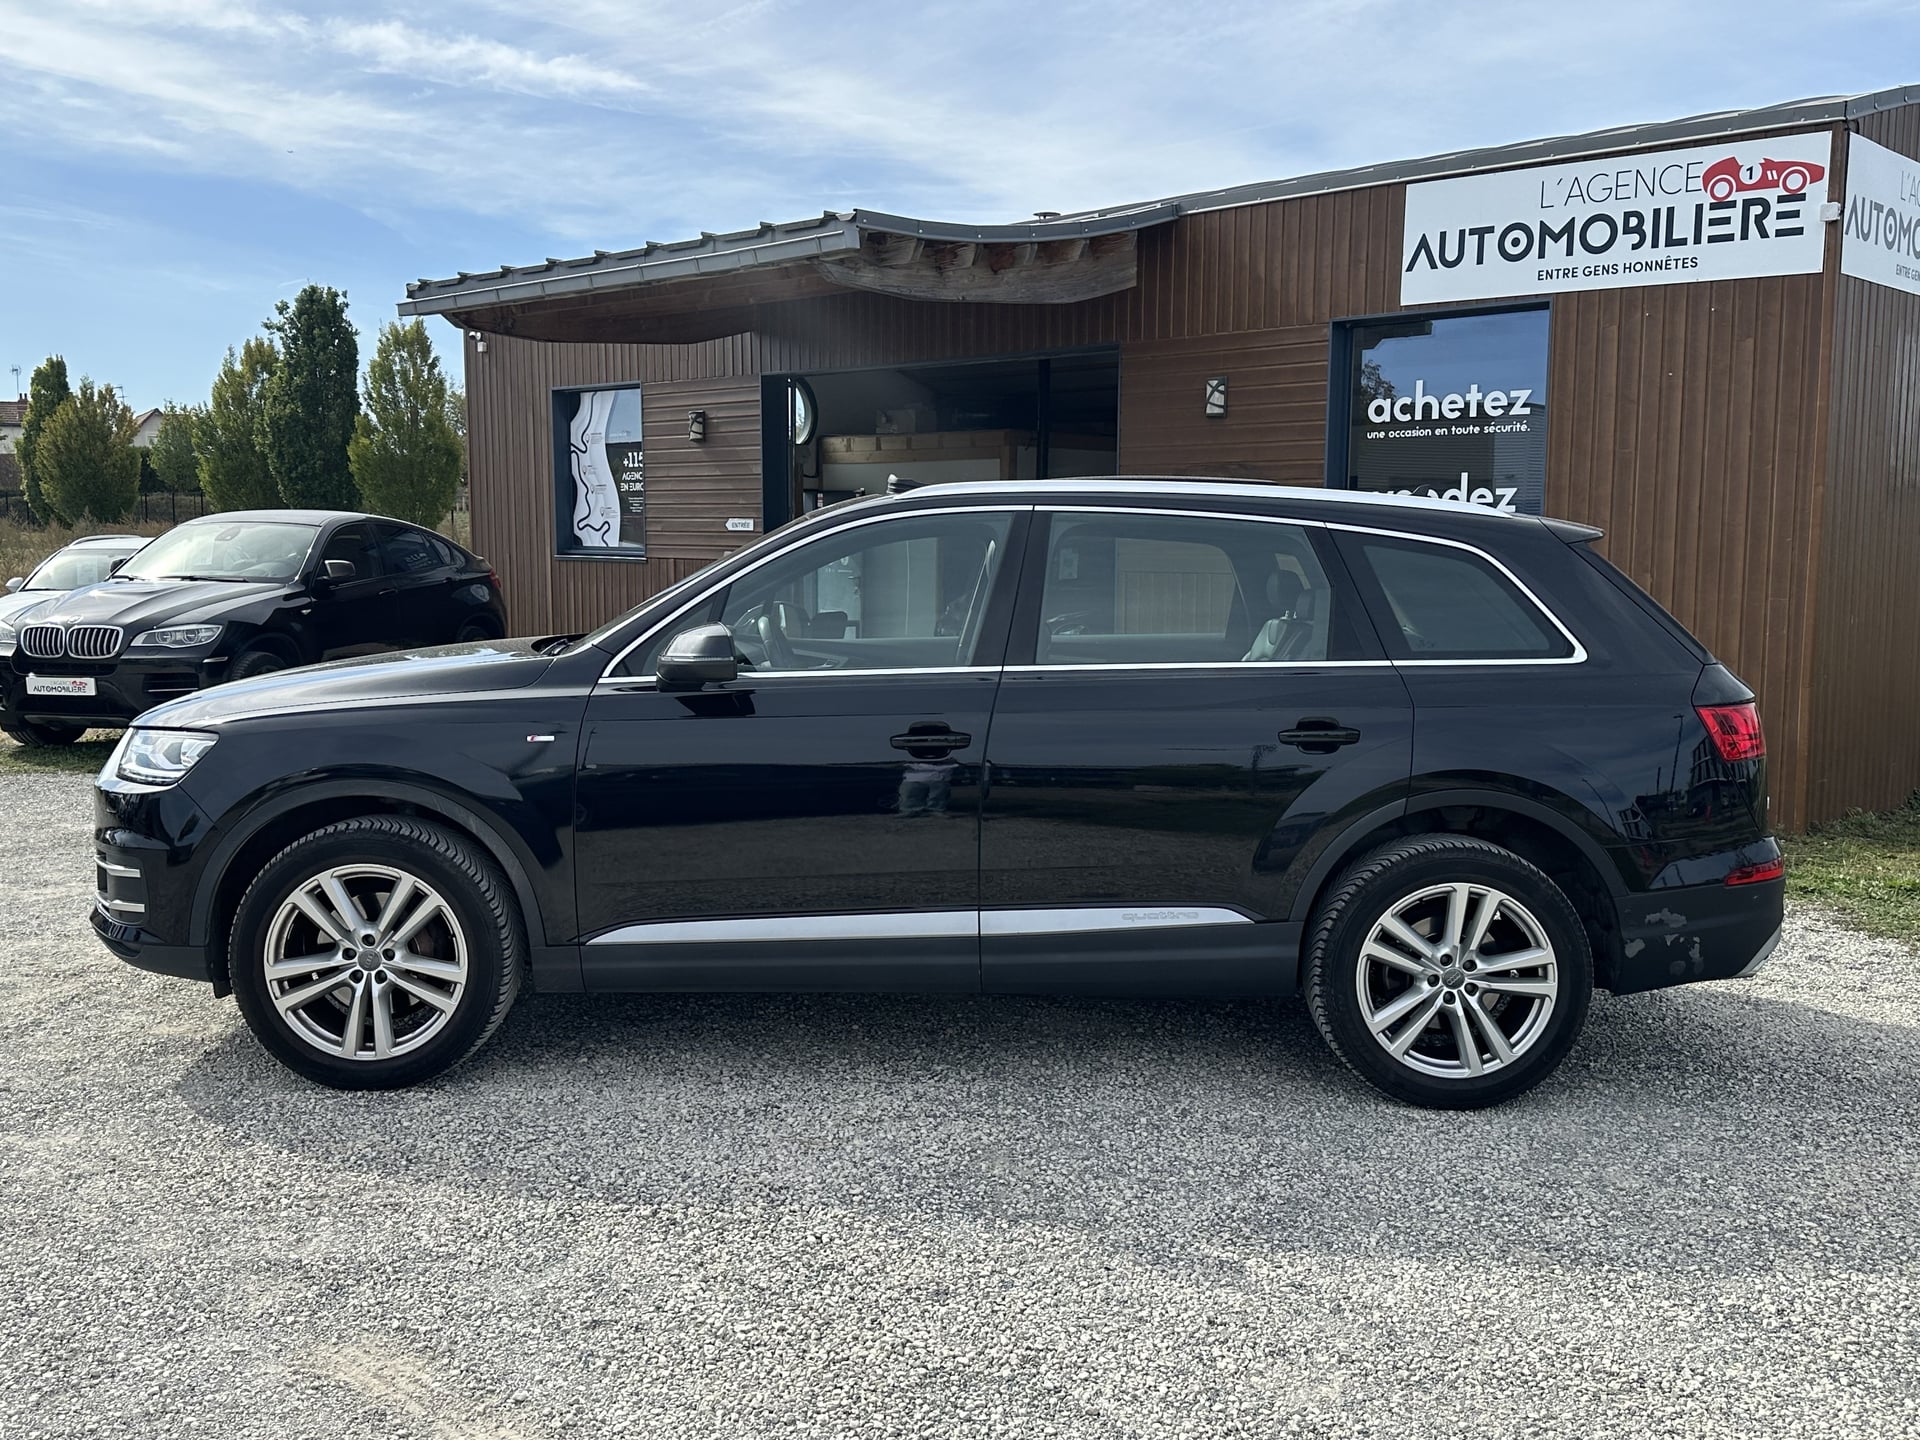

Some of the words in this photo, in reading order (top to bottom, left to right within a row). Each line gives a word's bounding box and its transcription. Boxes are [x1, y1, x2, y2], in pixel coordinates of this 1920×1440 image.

[1745, 165, 1753, 180] 1
[1540, 161, 1703, 209] L'AGENCE
[1537, 266, 1579, 281] ENTRE
[1582, 263, 1619, 277] GENS
[1623, 255, 1698, 274] HONNÊTES
[1895, 263, 1911, 279] ENTRE
[1367, 379, 1533, 424] achetez
[1366, 430, 1386, 439] une
[1388, 425, 1432, 438] occasion
[1435, 427, 1448, 436] en
[1451, 424, 1481, 435] toute
[1483, 419, 1531, 434] sécurité.
[620, 482, 629, 492] EN
[731, 520, 751, 529] ENTRÉE
